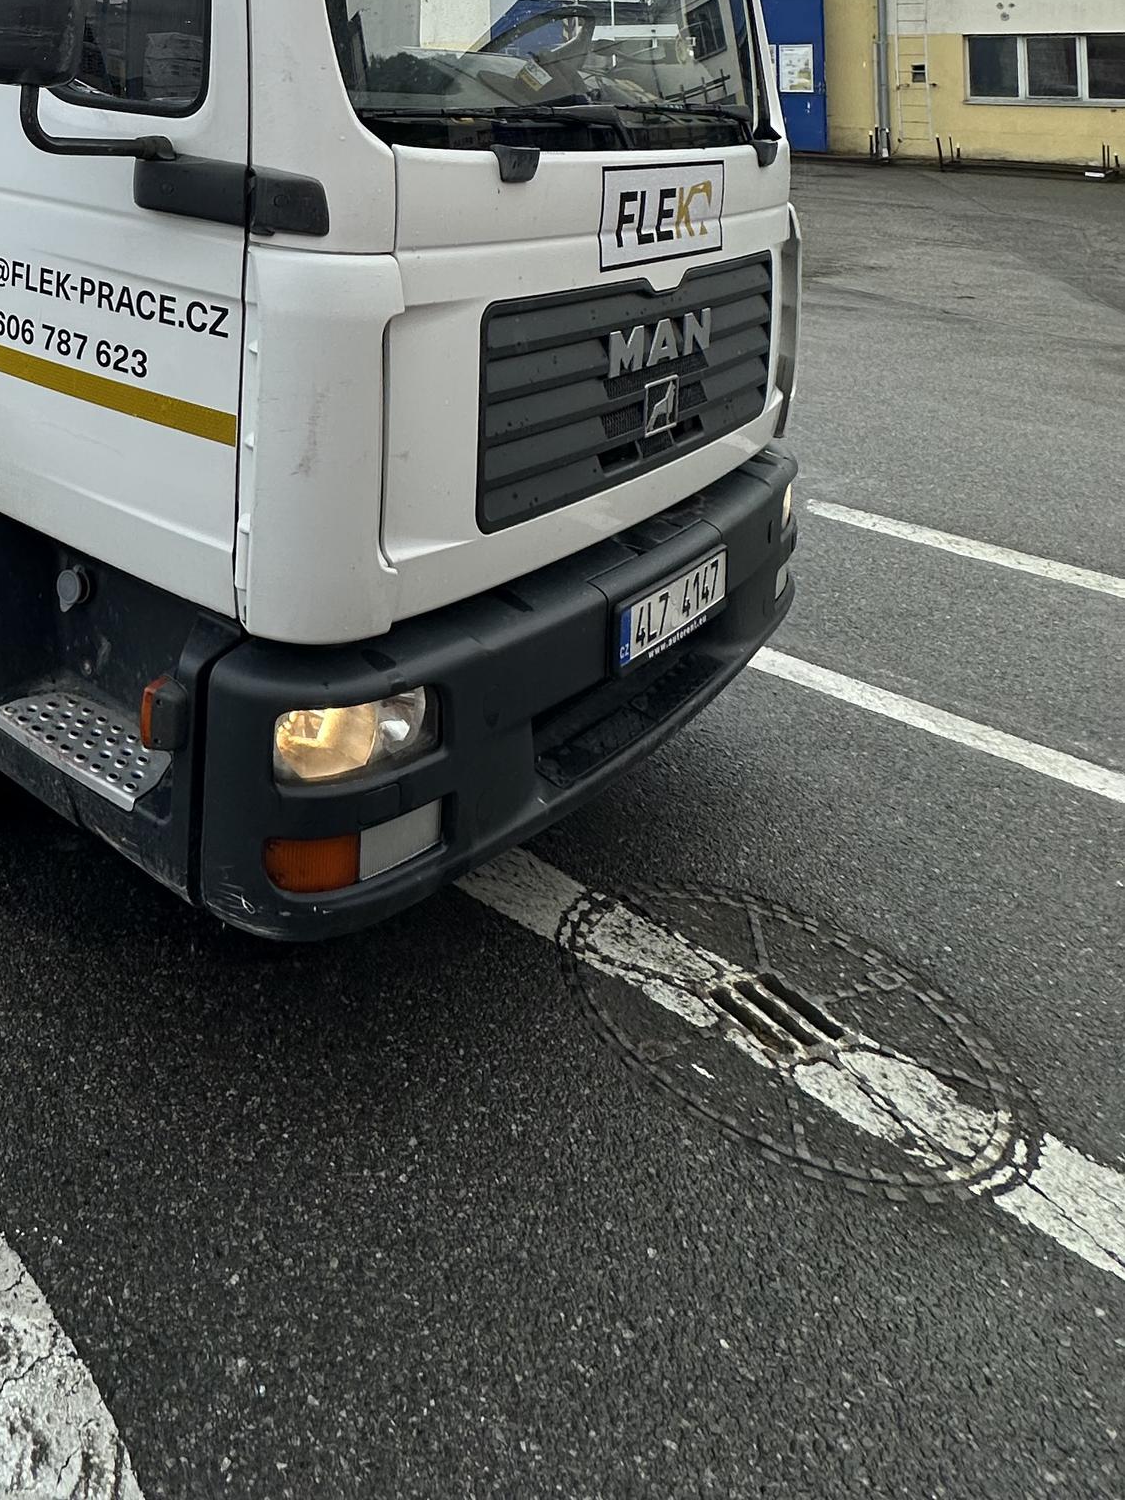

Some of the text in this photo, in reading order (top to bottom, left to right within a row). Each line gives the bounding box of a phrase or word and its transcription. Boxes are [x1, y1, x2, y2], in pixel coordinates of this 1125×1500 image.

[616, 180, 712, 248] FLEK
[42, 323, 88, 360] 787
[96, 340, 148, 378] 623
[608, 307, 712, 378] MAN
[635, 559, 719, 647] 4L7 4147
[619, 643, 630, 660] CZ
